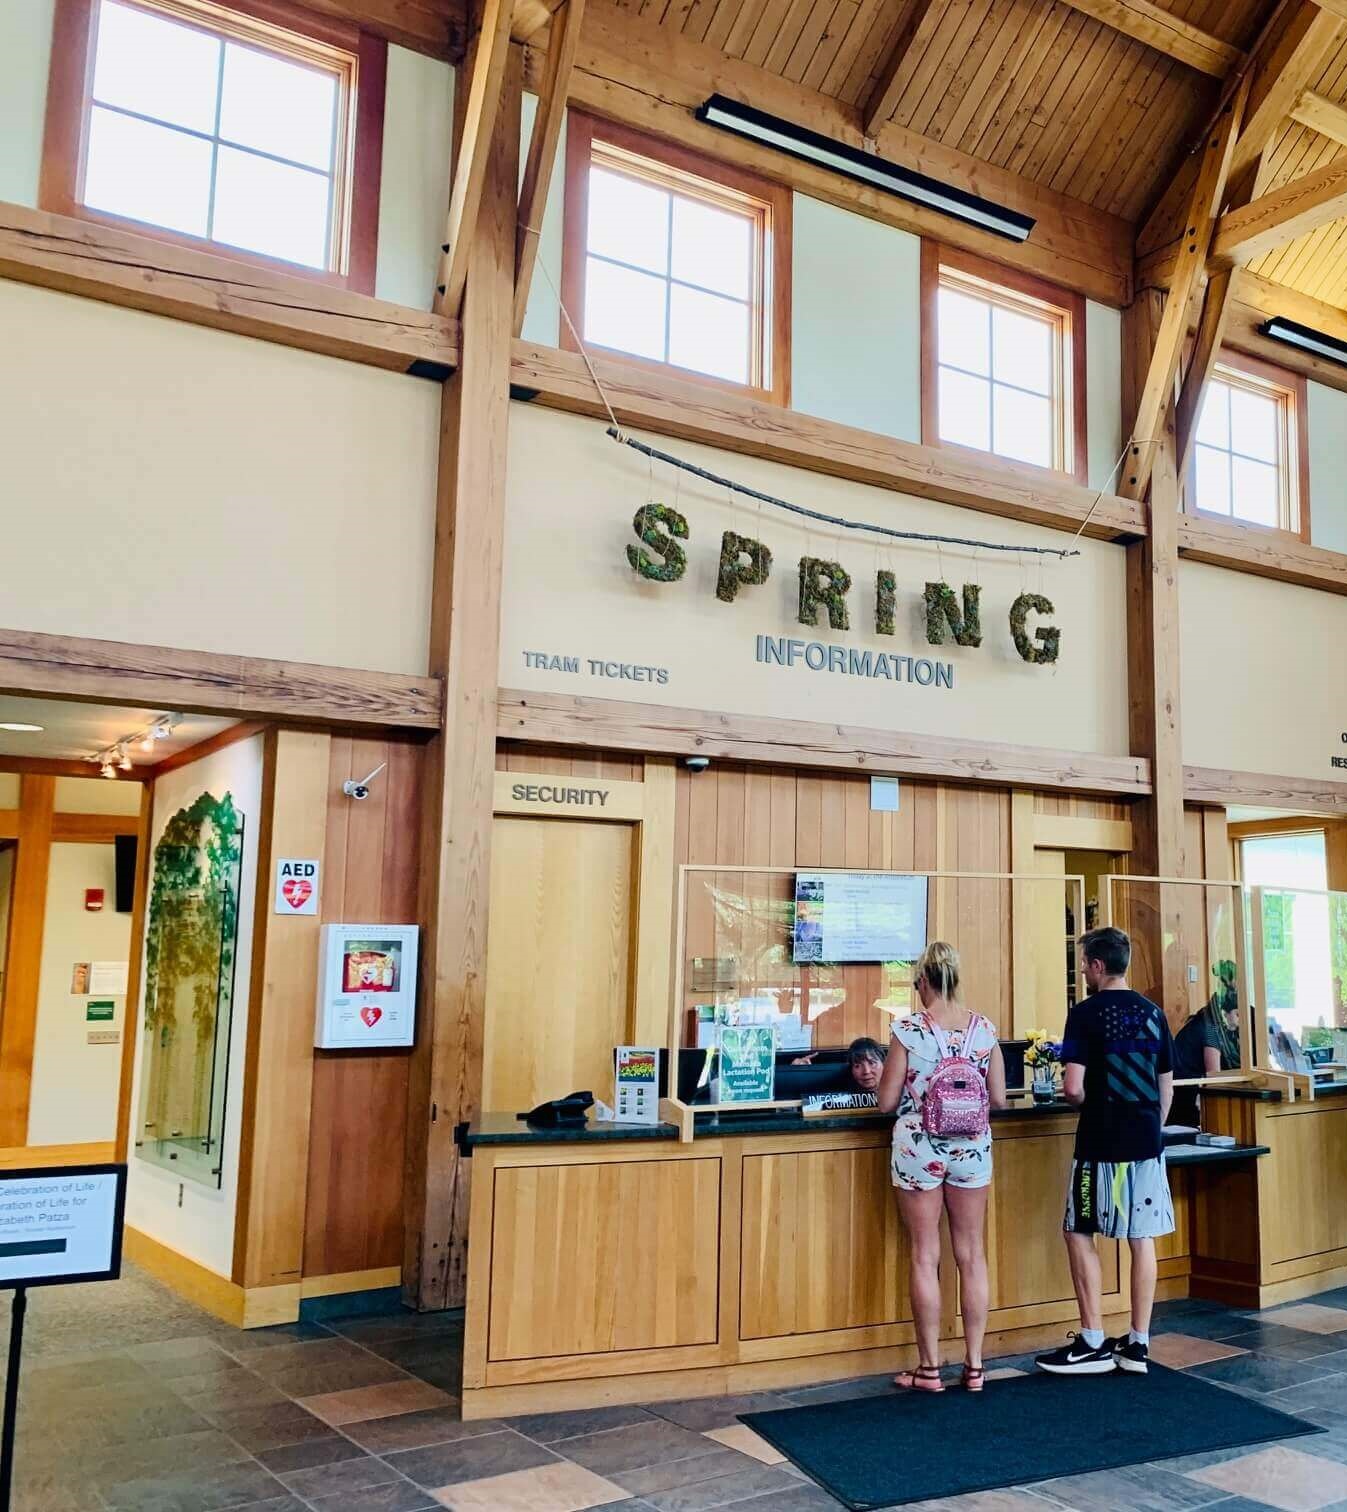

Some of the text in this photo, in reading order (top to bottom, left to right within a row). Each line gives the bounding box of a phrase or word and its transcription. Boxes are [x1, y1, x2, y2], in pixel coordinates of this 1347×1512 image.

[625, 502, 1062, 664] SPRING
[521, 650, 670, 685] TRAM TICKETS
[756, 634, 955, 690] INFORMATION
[511, 783, 610, 807] SECURITY
[281, 862, 316, 877] AED
